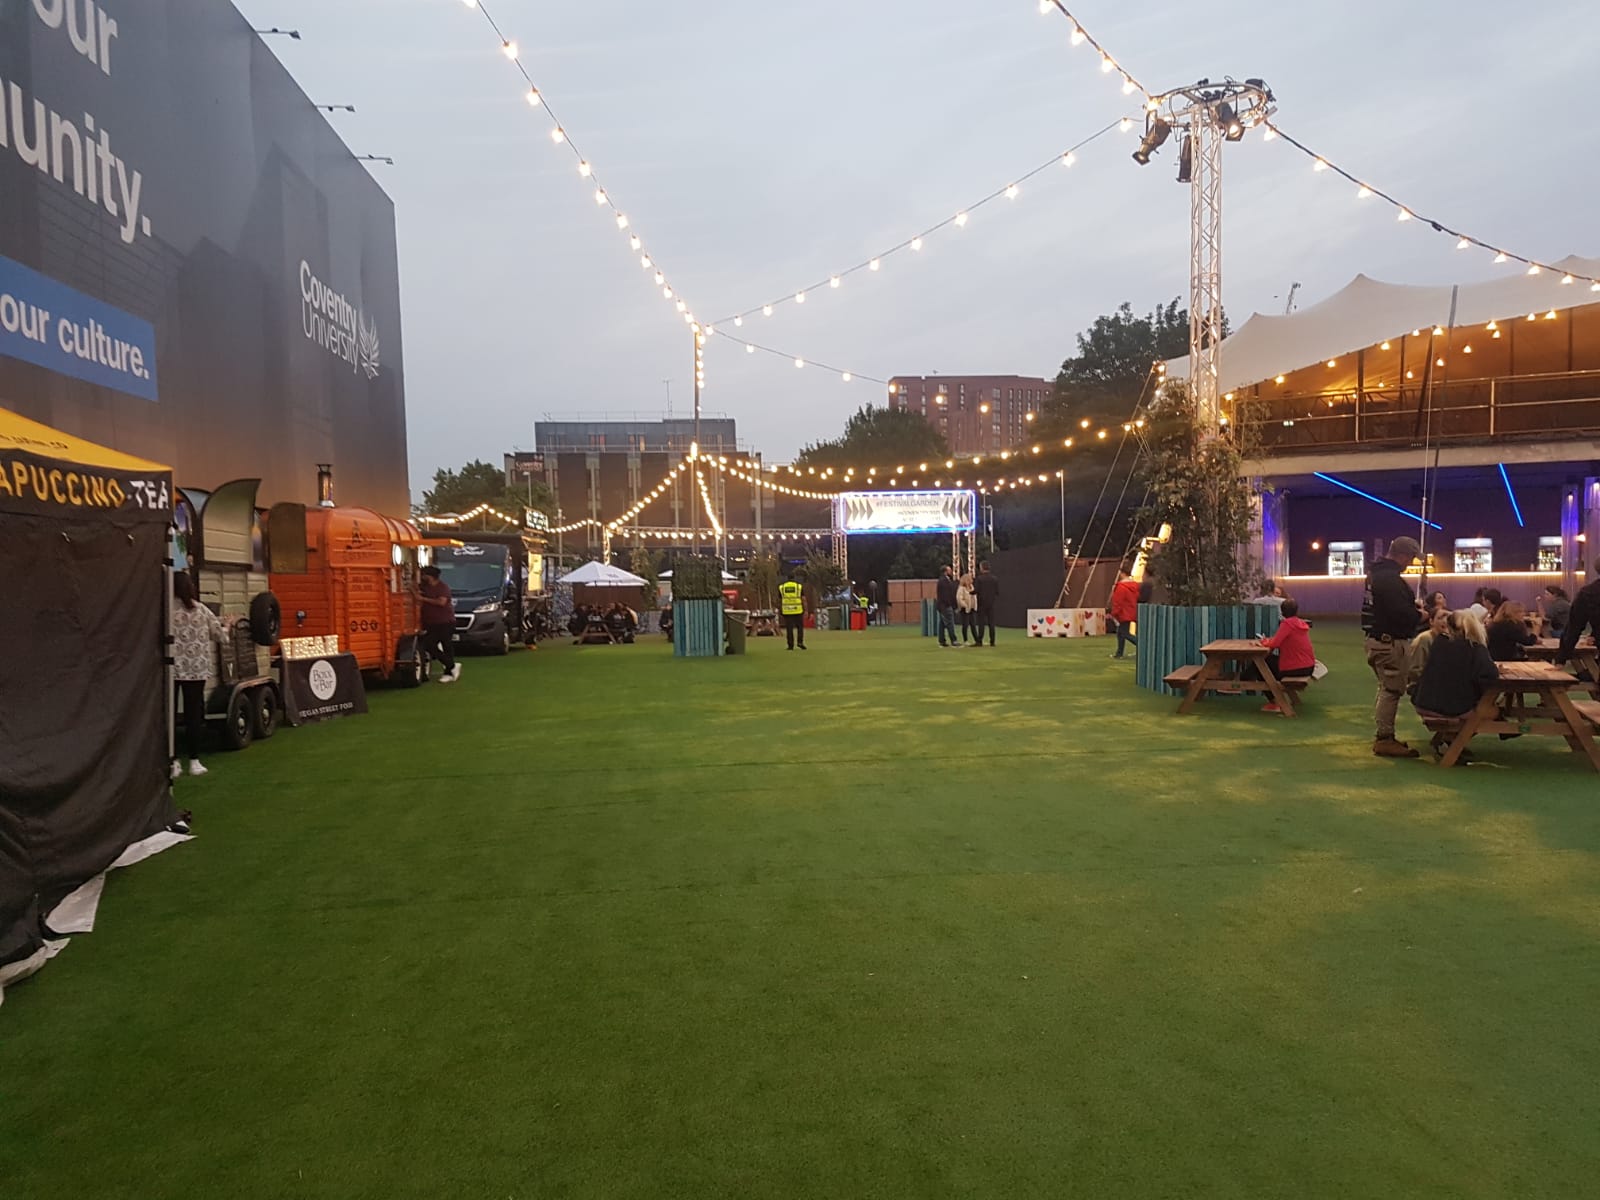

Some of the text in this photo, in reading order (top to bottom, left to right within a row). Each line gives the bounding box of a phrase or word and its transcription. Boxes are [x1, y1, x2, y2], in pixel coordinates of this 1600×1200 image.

[0, 77, 152, 244] unity.
[0, 293, 150, 380] our culture.
[300, 260, 356, 345] Coventry
[302, 297, 359, 374] University
[319, 704, 338, 714] STREET
